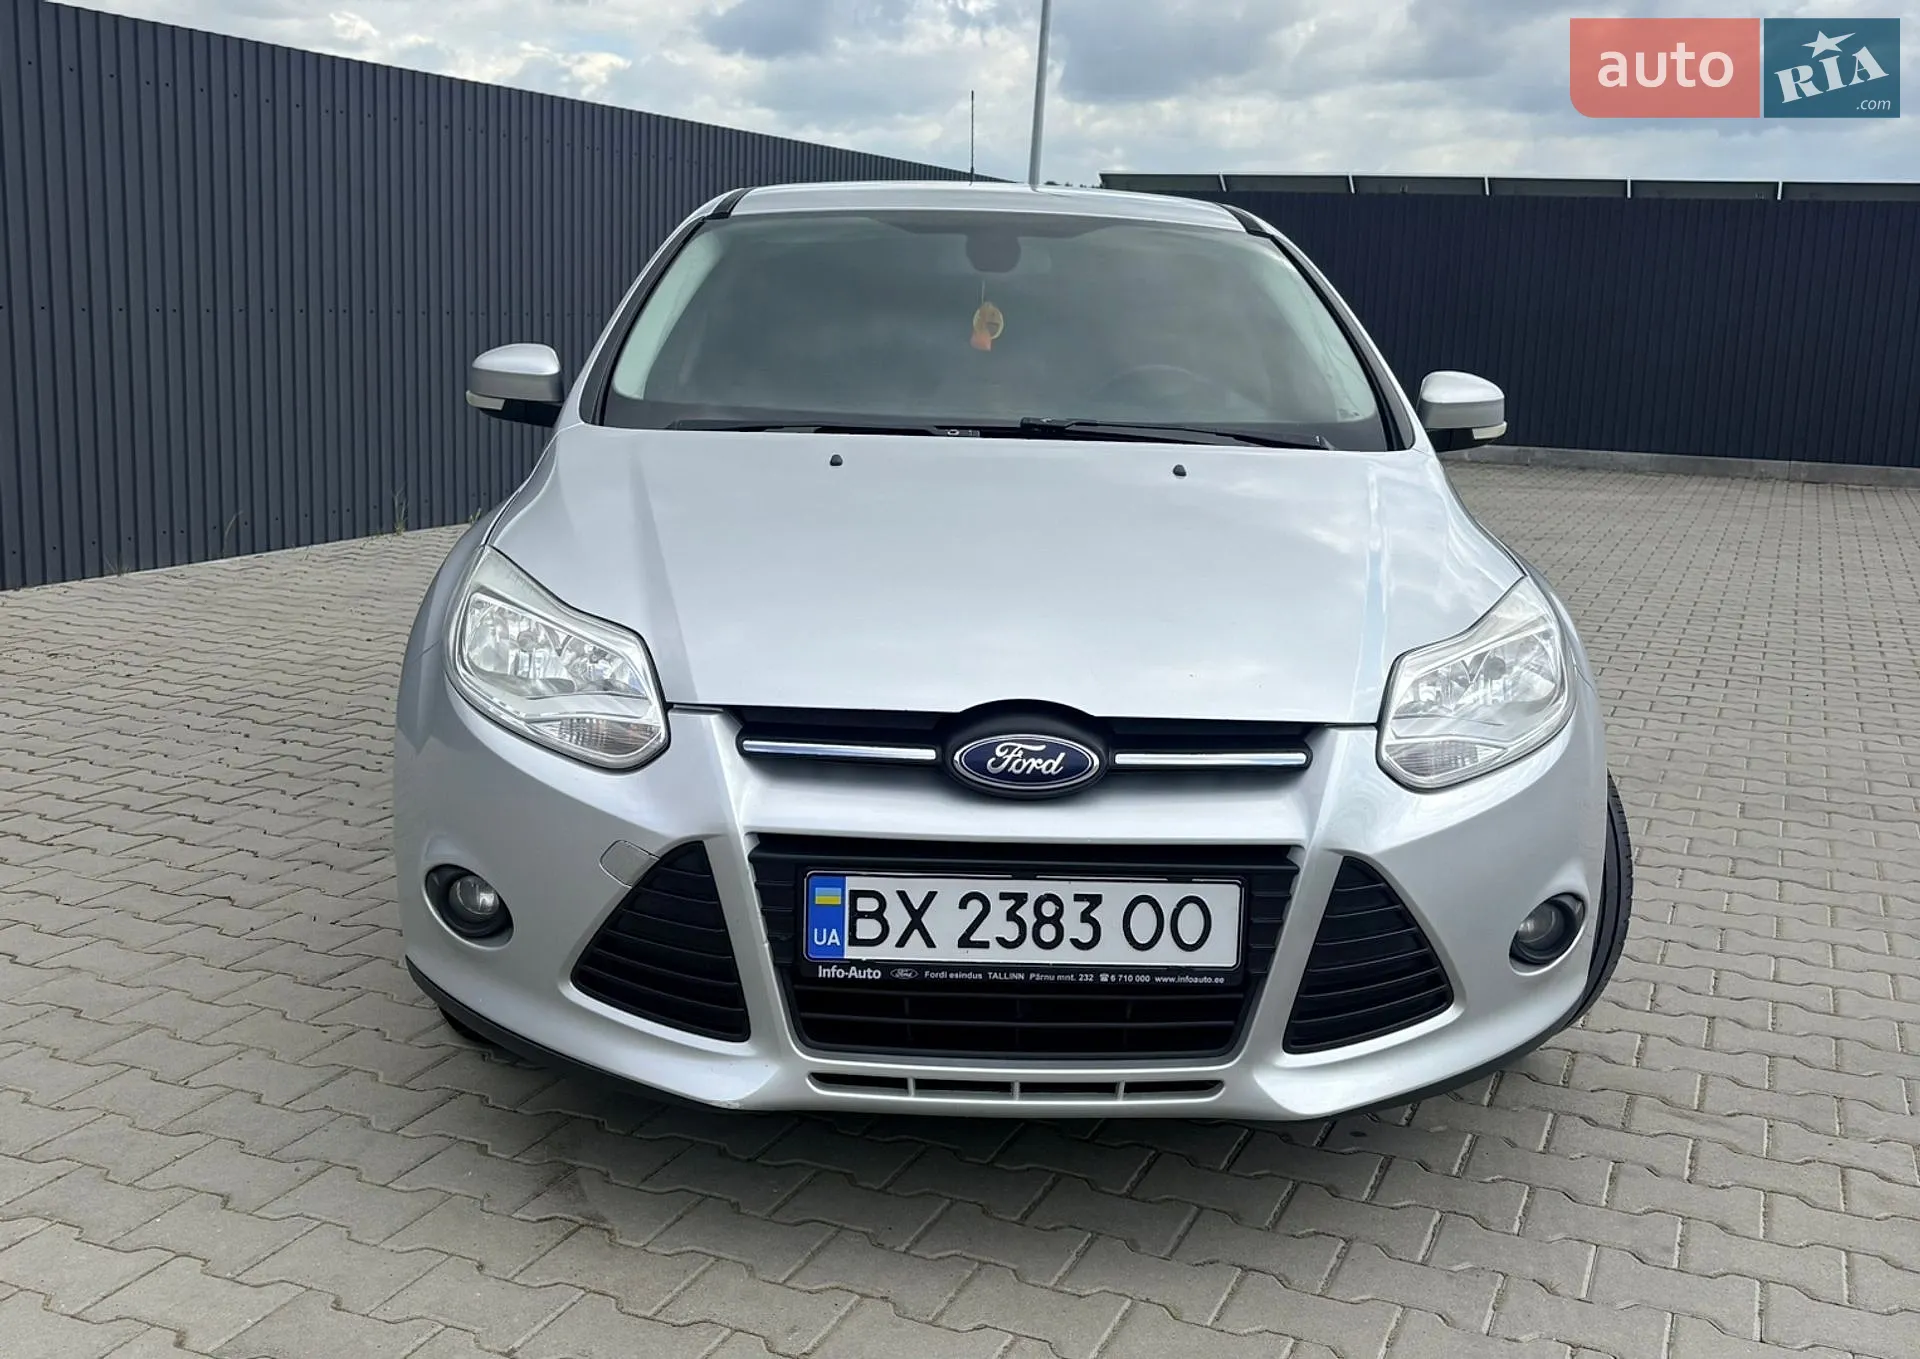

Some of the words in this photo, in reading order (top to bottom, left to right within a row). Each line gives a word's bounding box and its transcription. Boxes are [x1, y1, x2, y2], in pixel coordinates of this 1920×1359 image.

[986, 741, 1066, 775] Ford
[847, 888, 938, 949] BX
[957, 891, 1103, 951] 2383
[813, 928, 840, 947] UA
[817, 965, 882, 979] Info-Auto
[987, 972, 1025, 981] TALLINN
[1078, 973, 1095, 982] 232
[1118, 974, 1134, 983] 710
[1135, 975, 1151, 983] 000
[1154, 975, 1225, 984] www.infoauto.ee
